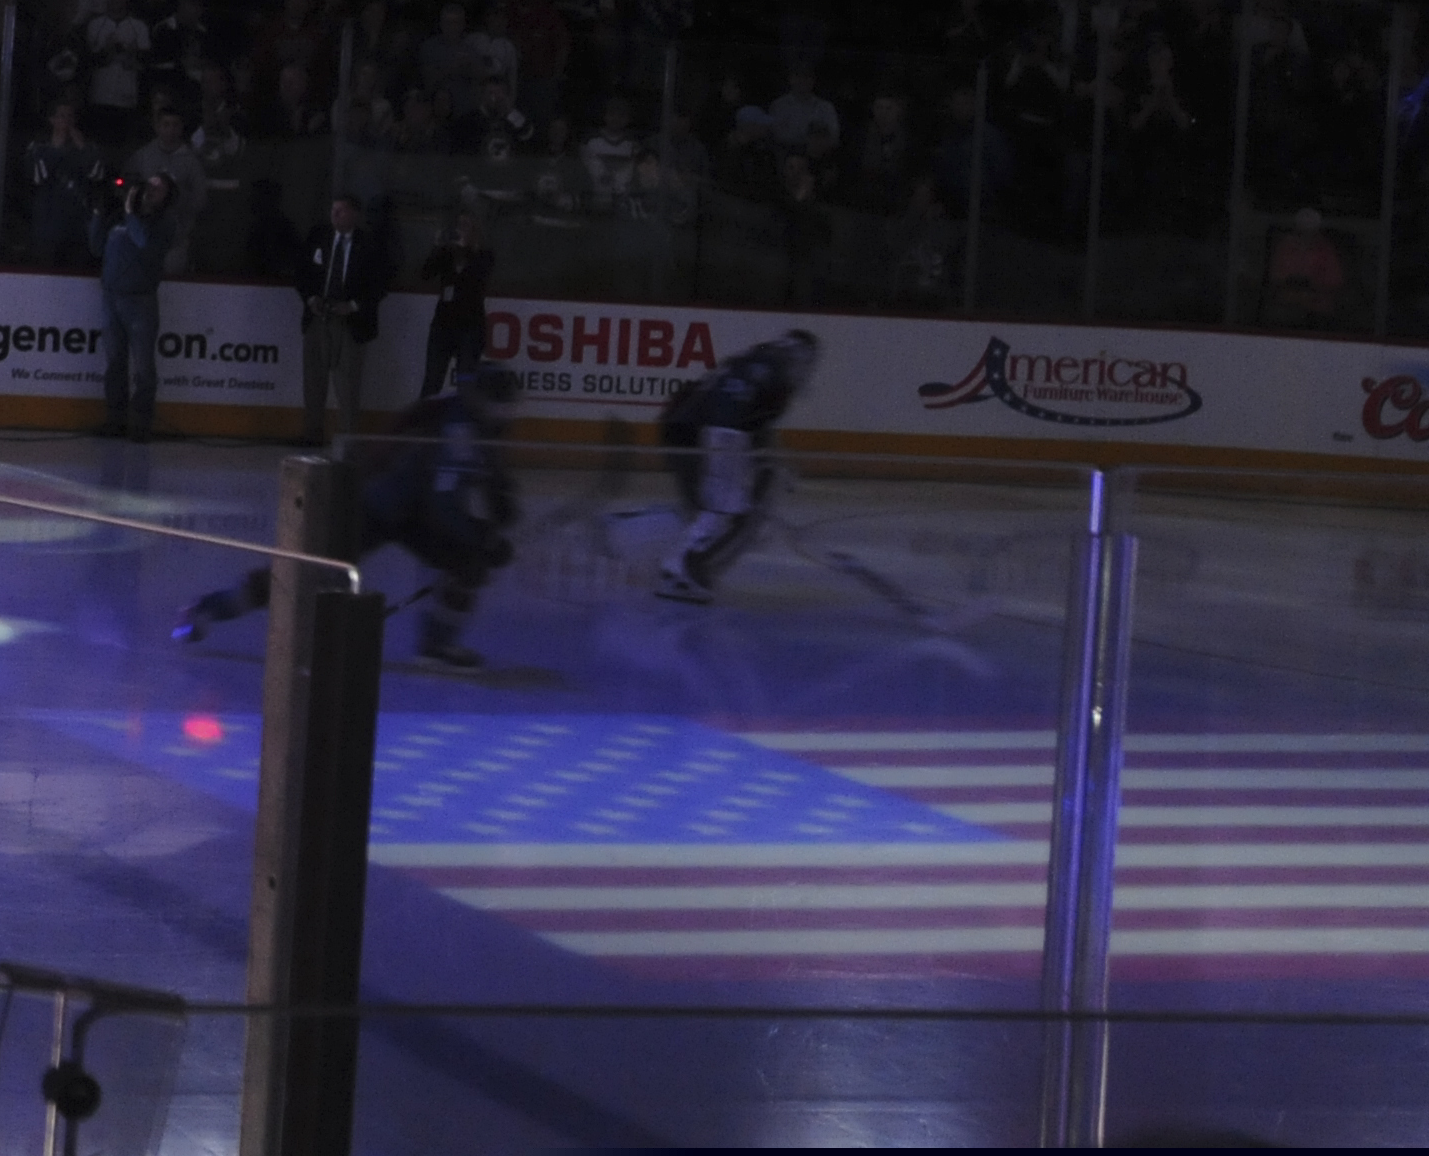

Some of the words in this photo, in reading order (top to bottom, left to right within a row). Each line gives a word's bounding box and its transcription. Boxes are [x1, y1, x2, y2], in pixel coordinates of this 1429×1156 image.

[484, 310, 717, 370] OSHIBA
[11, 367, 31, 380] We
[34, 369, 82, 383] Connect
[164, 376, 189, 388] with
[192, 376, 224, 390] Great
[228, 377, 276, 391] Dentists
[583, 373, 699, 396] SOLUTIO
[1022, 384, 1094, 402] Furniture
[1096, 386, 1184, 405] Warehouse
